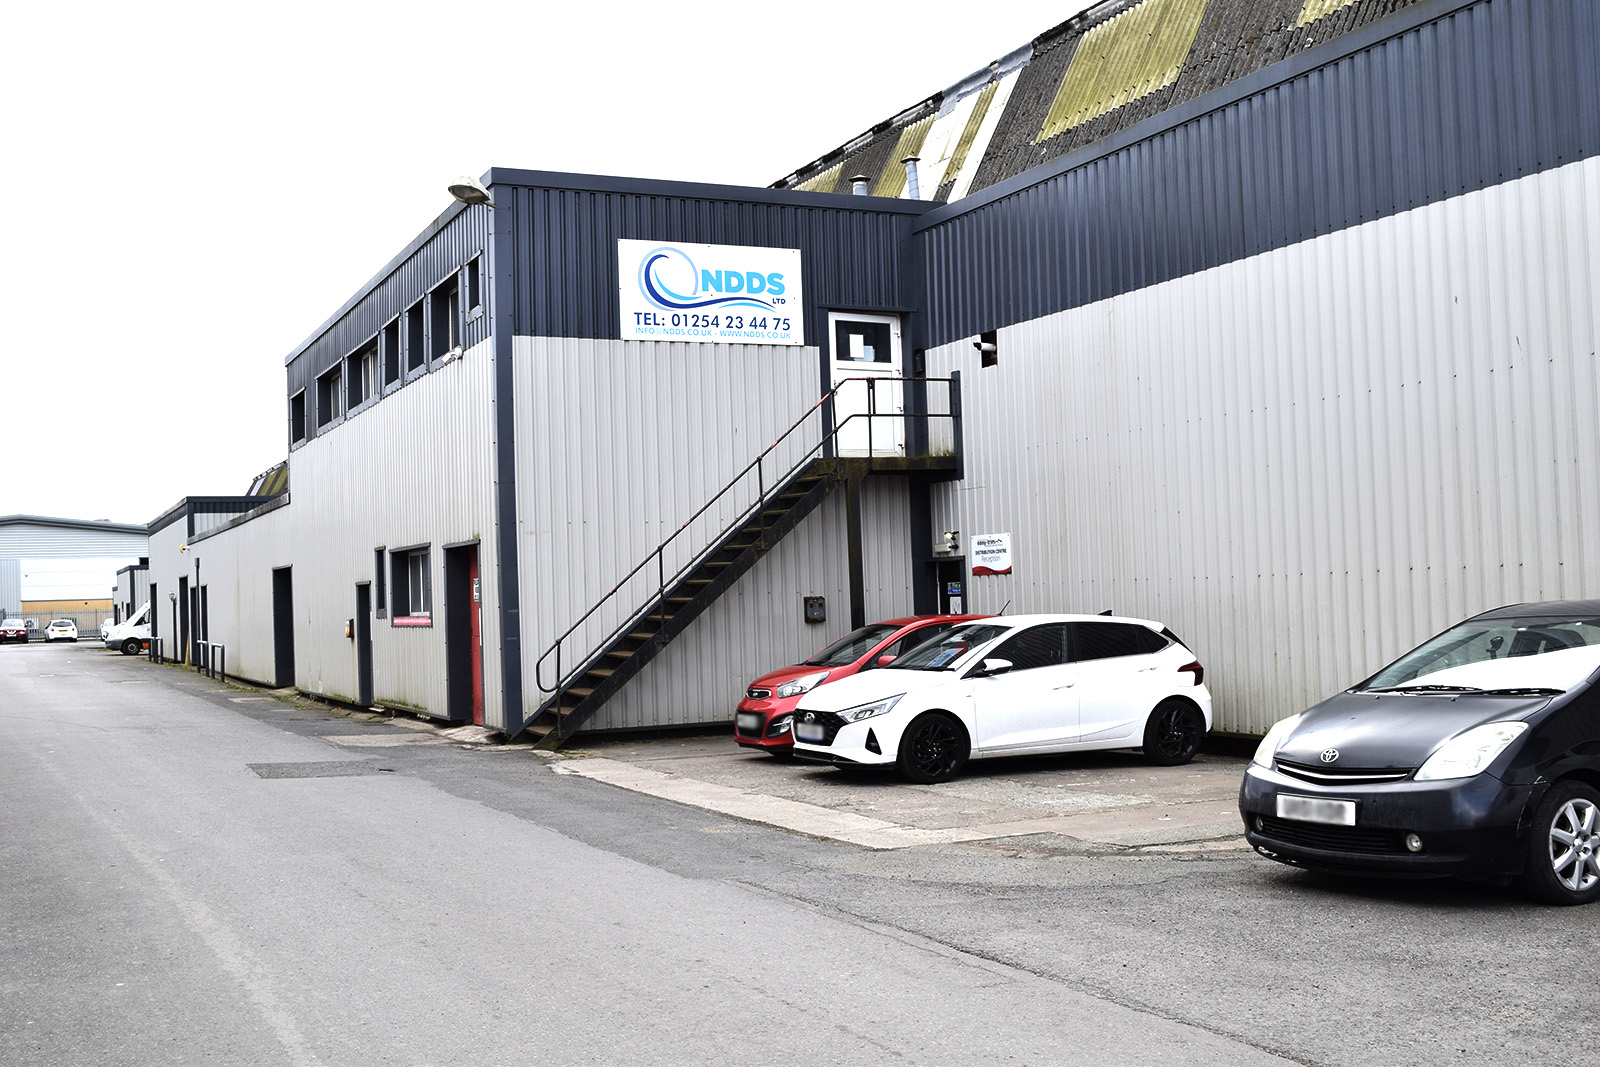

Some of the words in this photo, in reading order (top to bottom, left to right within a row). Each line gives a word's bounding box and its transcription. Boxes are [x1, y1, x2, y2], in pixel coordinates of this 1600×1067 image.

[701, 269, 785, 295] NDDS
[634, 312, 665, 326] TEL:
[671, 313, 719, 328] 01254
[725, 315, 743, 329] 23
[749, 317, 767, 330] 44
[773, 318, 790, 331] 75
[635, 327, 712, 336] INFO@NDDS.CO.UK
[720, 330, 791, 339] WWW.NDDS.CO.UK
